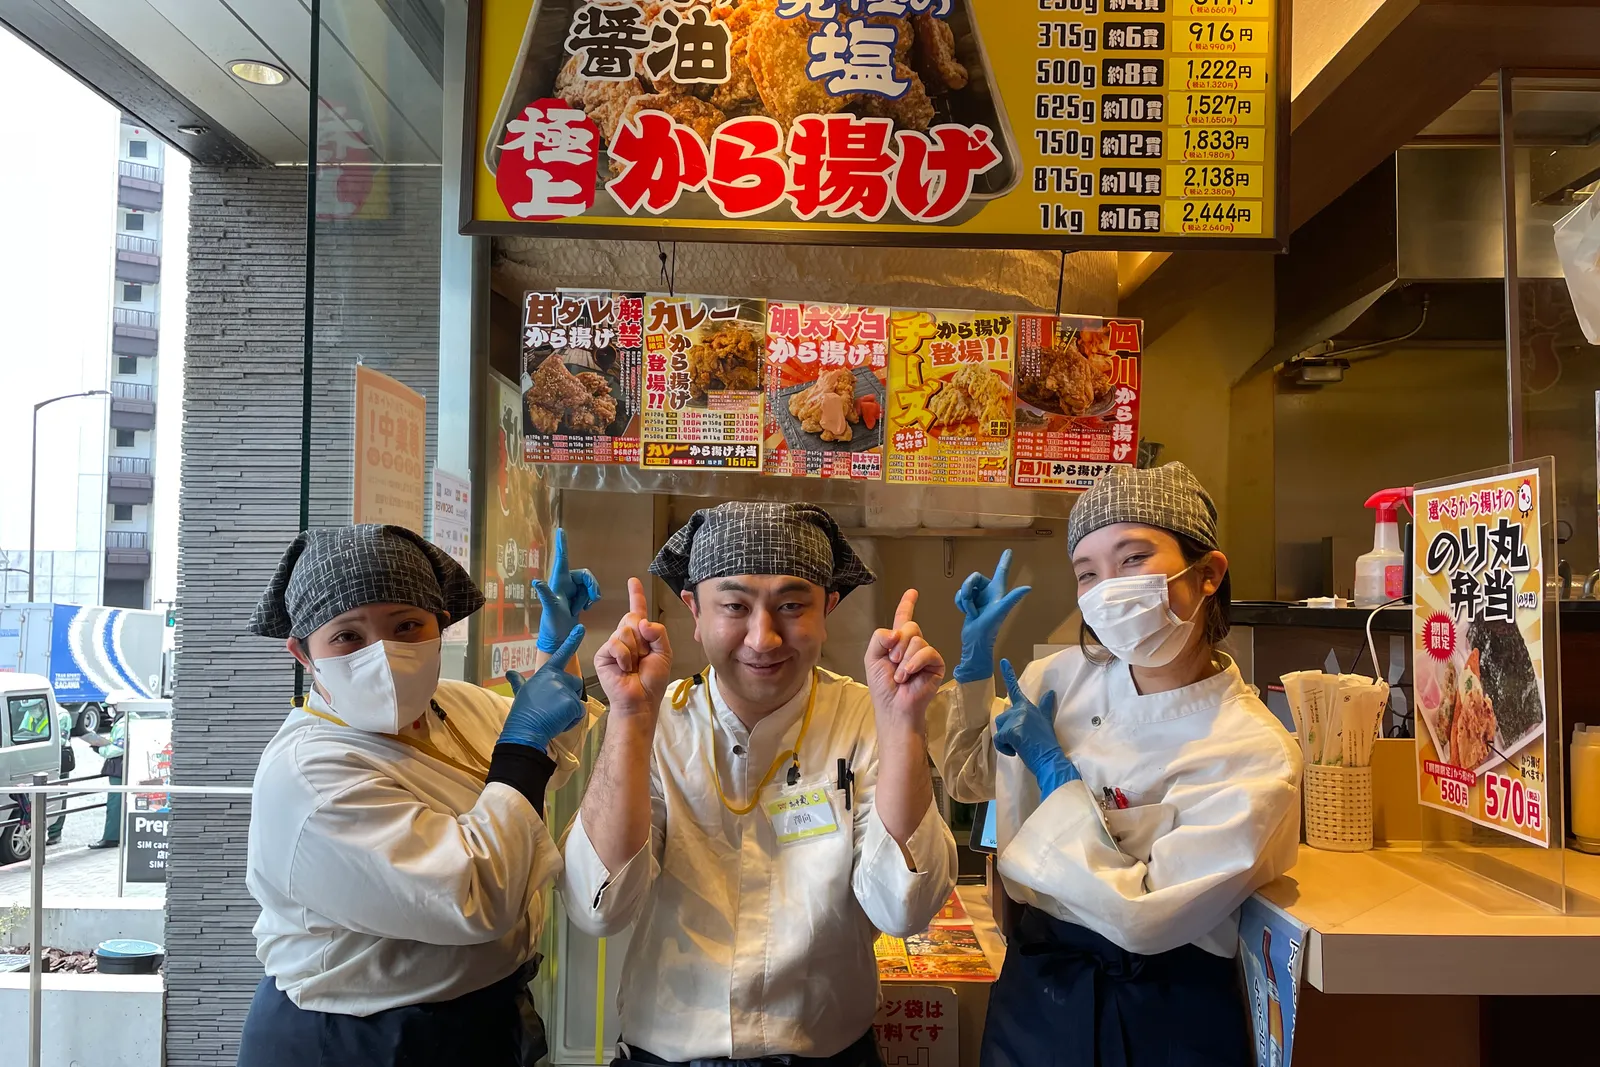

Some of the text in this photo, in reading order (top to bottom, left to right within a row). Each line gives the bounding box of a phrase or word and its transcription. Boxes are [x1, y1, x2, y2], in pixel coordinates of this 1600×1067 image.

[567, 5, 730, 82] 醤油
[1038, 22, 1253, 51] 375g 約6貫 916円
[807, 19, 910, 97] 塩
[1037, 60, 1252, 88] 500g 約8貫 1,222円
[1035, 94, 1251, 123] 625g 約10貫 1,527円
[1035, 130, 1249, 159] 750g 約12貫 1,833円
[498, 106, 595, 217] 極上
[608, 112, 1002, 221] から揚げ
[1033, 167, 1250, 197] 875g 約14貫 2,138円
[1040, 203, 1251, 233] 1kg 約16貫 2,444円
[526, 293, 616, 326] 甘ダレ
[617, 296, 643, 348] 解禁
[647, 300, 740, 333] カレー
[768, 306, 887, 341] 明太マヨ
[526, 327, 614, 348] から揚げ
[937, 316, 1011, 339] から揚げ
[768, 339, 870, 366] から揚げ
[929, 337, 1009, 367] 登場!!
[1108, 321, 1140, 389] 四川
[668, 333, 693, 411] から揚げ
[891, 312, 942, 432] チーズ
[896, 431, 924, 441] みんな
[1112, 388, 1136, 460] から揚げ
[647, 444, 757, 457] カレーから揚げ弁当
[896, 438, 927, 450] 大好き!
[1428, 489, 1515, 521] 選べるから揚げの
[1427, 519, 1529, 573] のり丸
[1451, 570, 1514, 622] 弁当
[1431, 622, 1449, 636] 期間
[1431, 635, 1450, 650] 限定
[54, 681, 80, 690] SAGAWA
[1521, 754, 1540, 768] から揚げ
[1441, 780, 1468, 805] 580円
[1486, 774, 1540, 828] 570円
[137, 841, 152, 849] SIM
[149, 861, 163, 869] SIM
[879, 1000, 943, 1018] ジ袋は
